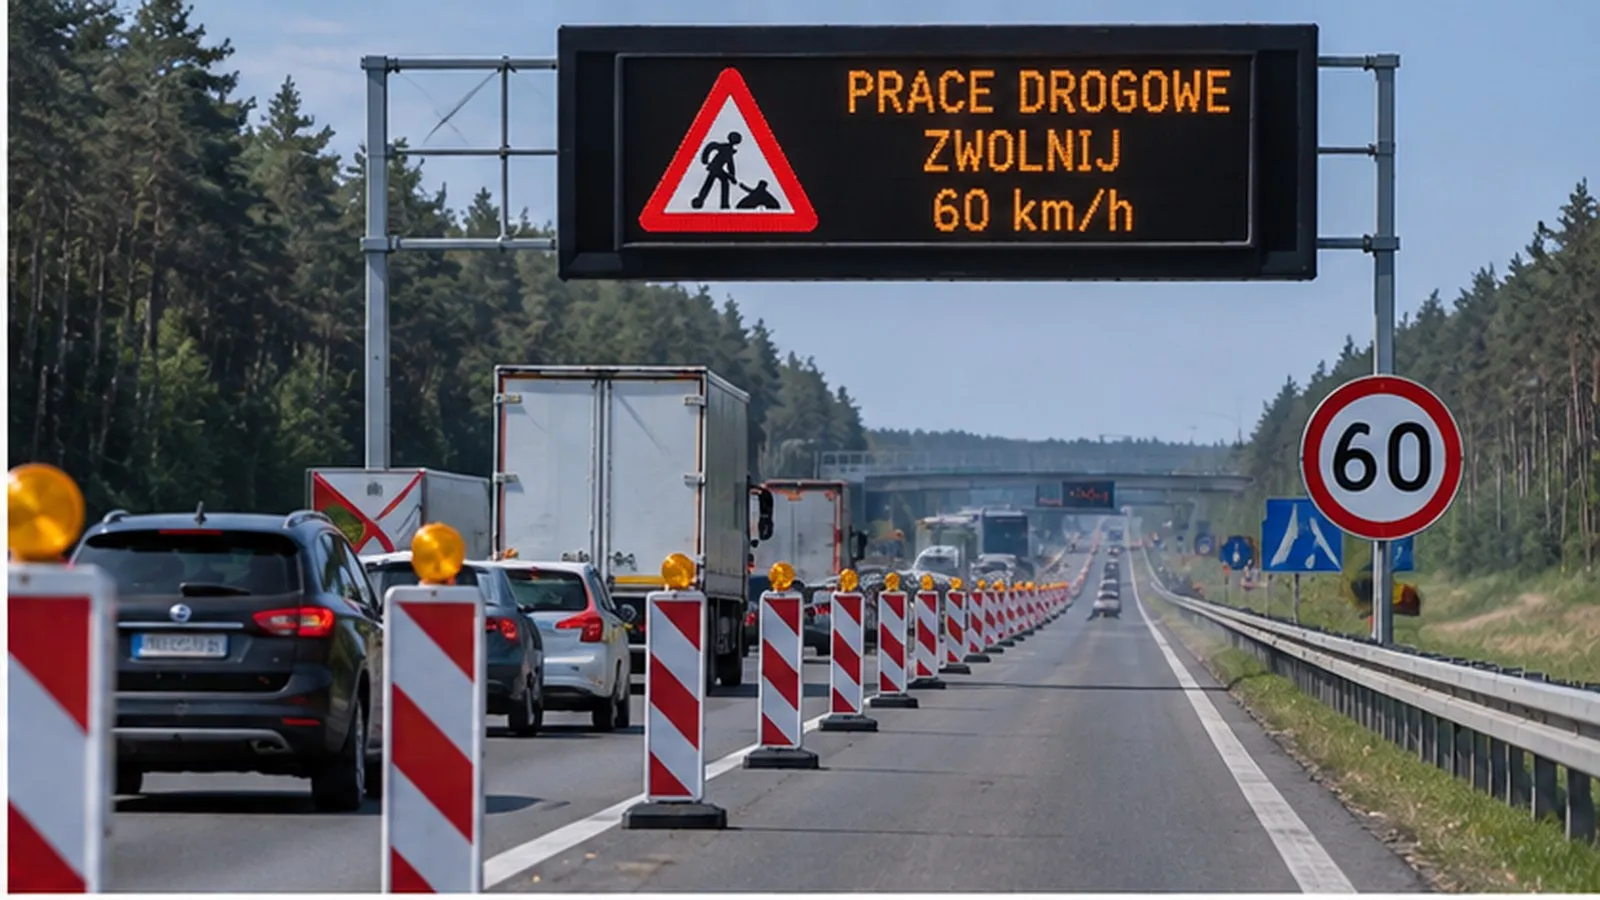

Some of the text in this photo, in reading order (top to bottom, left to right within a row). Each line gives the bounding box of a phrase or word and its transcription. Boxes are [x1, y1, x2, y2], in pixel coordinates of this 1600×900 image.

[848, 70, 1232, 114] PRACE DROGOWE
[924, 130, 1121, 173] ZWOLNIJ
[934, 188, 1134, 233] 60 km/h
[1333, 421, 1432, 493] 60
